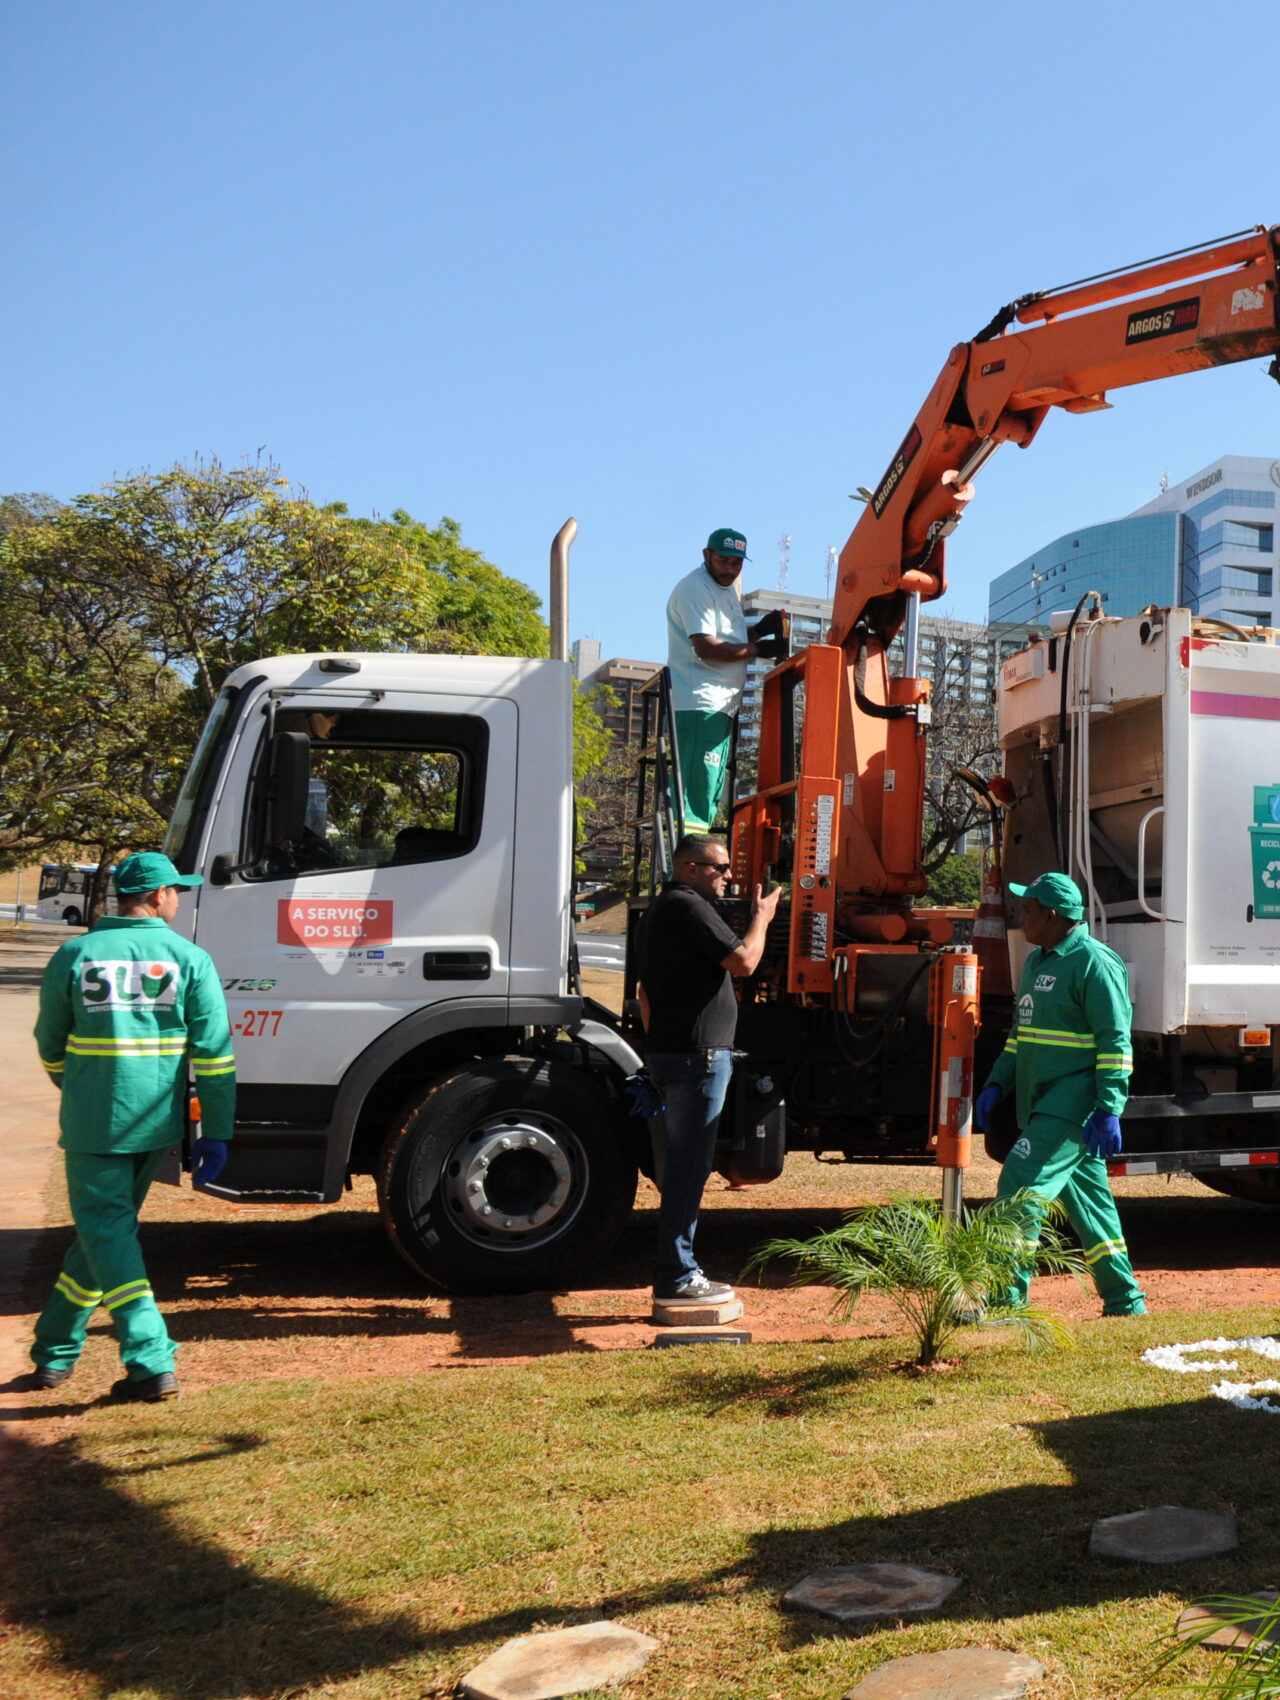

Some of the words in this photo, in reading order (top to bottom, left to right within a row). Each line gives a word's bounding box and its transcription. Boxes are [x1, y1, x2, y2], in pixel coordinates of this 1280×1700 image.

[1128, 315, 1162, 337] ARGOS
[874, 471, 897, 513] ARGOS
[1186, 469, 1222, 499] WINDSOR
[292, 908, 304, 920] A
[307, 908, 379, 923] SERVIÇO
[304, 925, 329, 938] DO
[333, 925, 367, 938] SLU.
[83, 965, 174, 1002] SLU
[229, 1010, 284, 1036] -277
